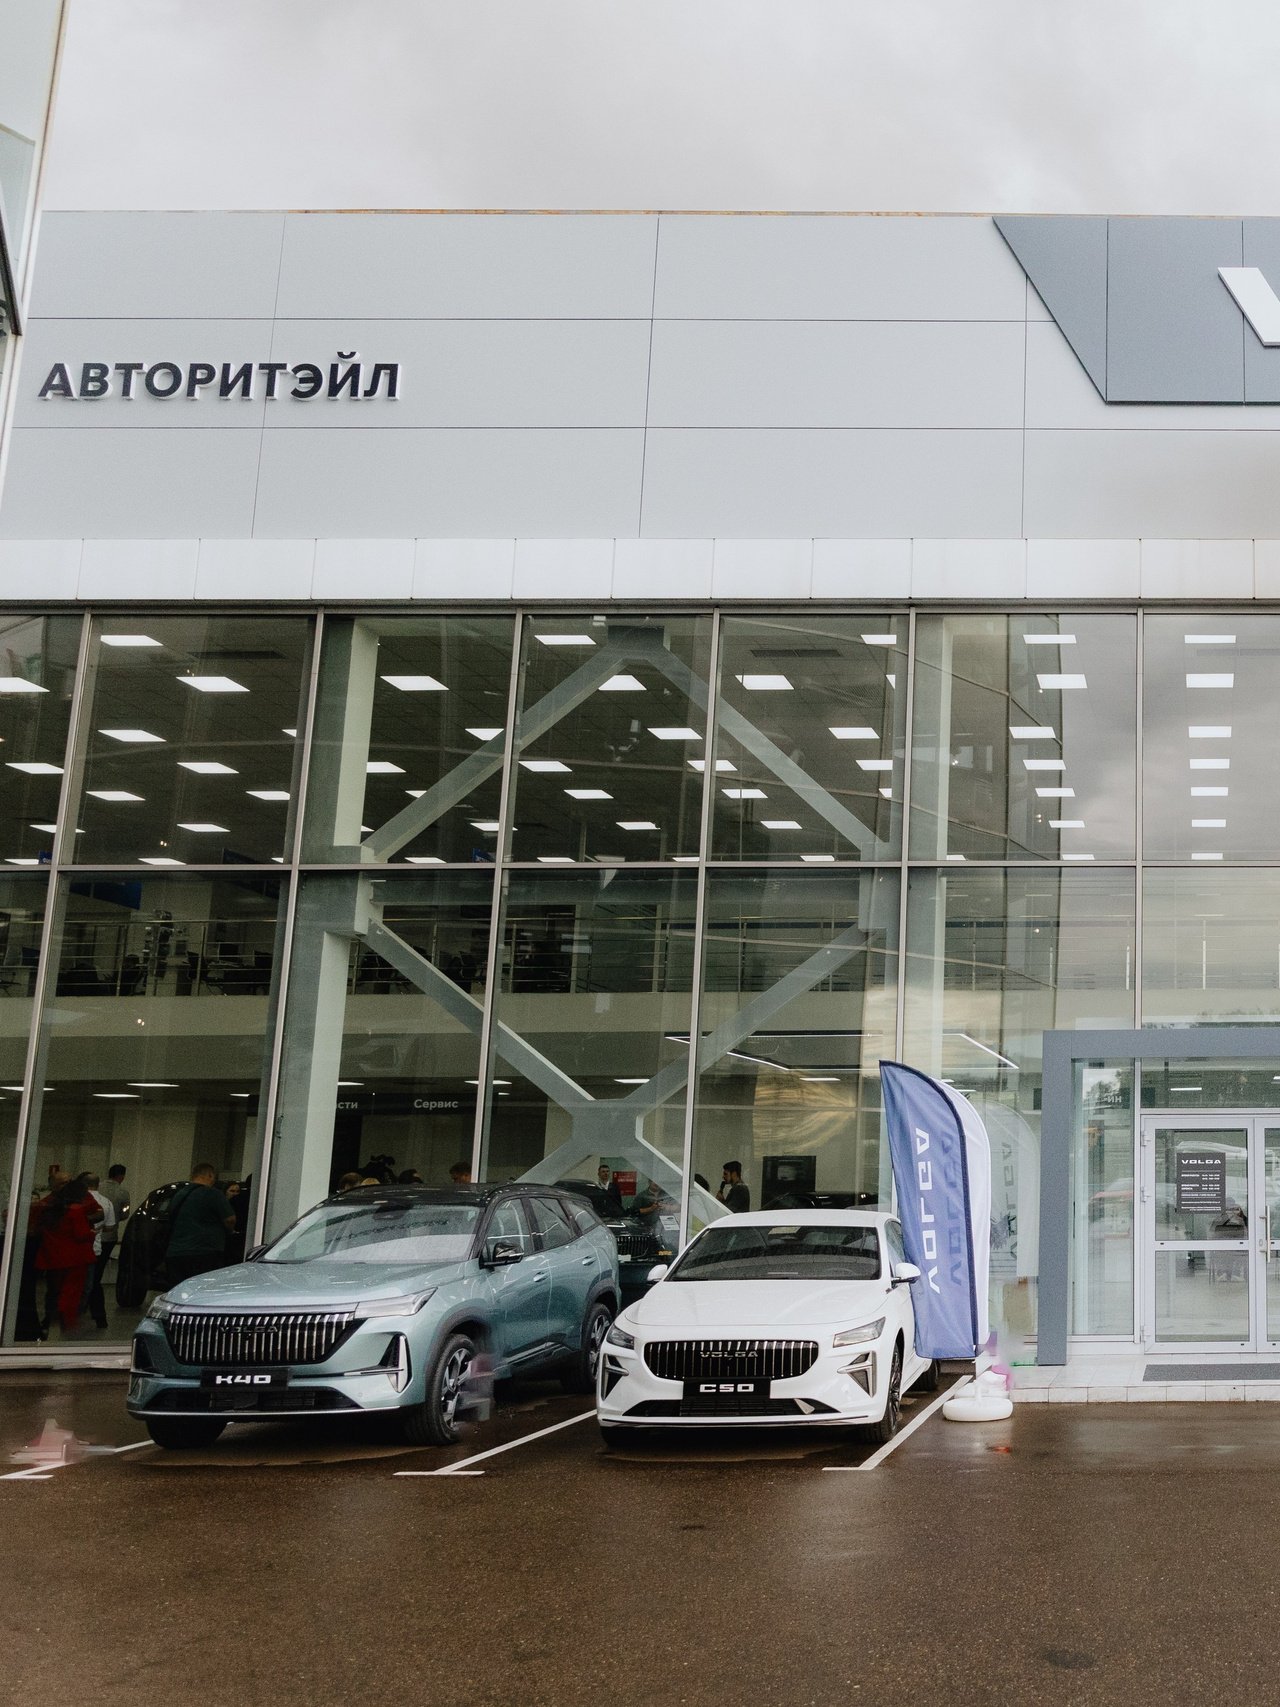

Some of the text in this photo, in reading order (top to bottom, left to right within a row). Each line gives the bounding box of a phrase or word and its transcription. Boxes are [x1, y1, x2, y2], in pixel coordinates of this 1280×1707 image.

[38, 351, 400, 400] АВТОРИТЭЙЛ
[414, 1099, 459, 1110] Сервис
[700, 1350, 759, 1358] VOLGA
[215, 1374, 272, 1385] K40
[699, 1383, 755, 1393] C50
